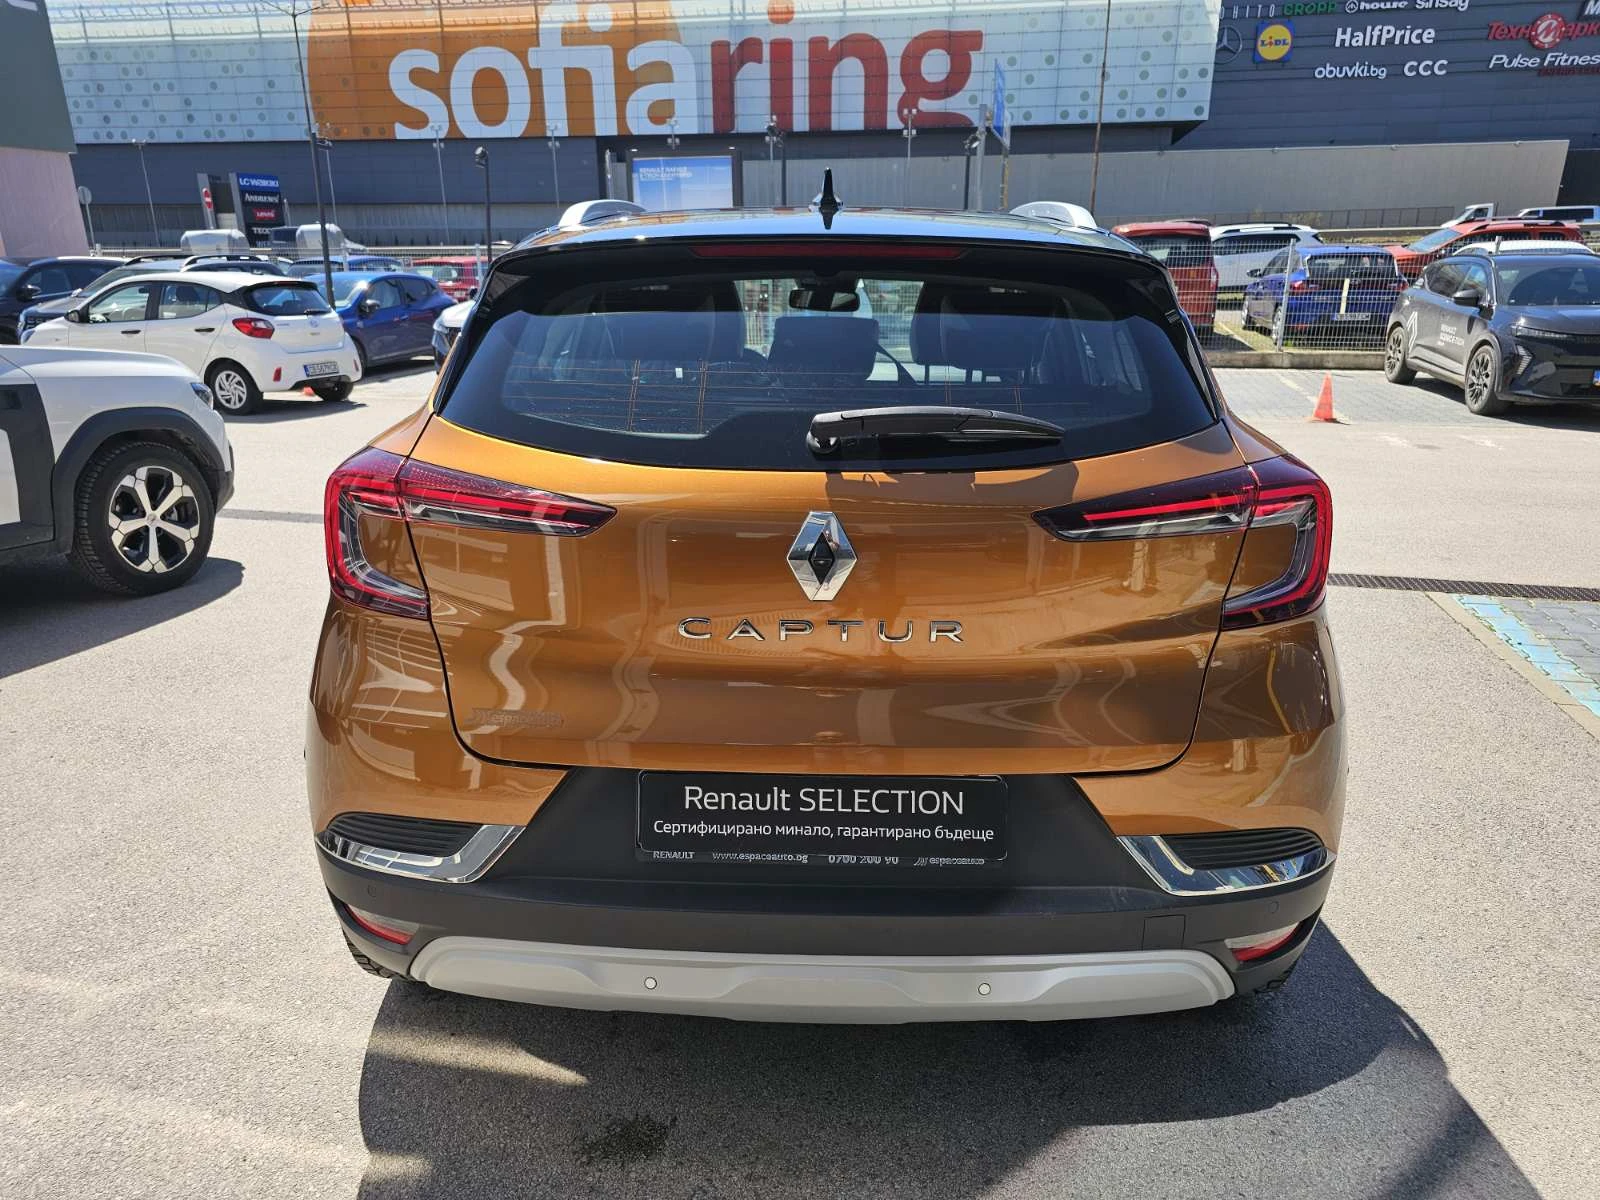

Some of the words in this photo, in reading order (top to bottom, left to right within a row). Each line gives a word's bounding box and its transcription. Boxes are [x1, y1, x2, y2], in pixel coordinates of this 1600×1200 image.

[1335, 25, 1436, 47] HalfPrice
[1315, 61, 1387, 80] obuvki.bg
[1403, 59, 1449, 77] CCC
[1489, 54, 1540, 69] Pulse
[677, 617, 965, 643] CAPTUR
[684, 786, 792, 812] Renault
[799, 788, 965, 816] SELECTION
[653, 820, 772, 838] Сертифицирано
[775, 825, 834, 838] минало,
[837, 826, 931, 841] гарантирано
[934, 825, 995, 843] бъдеще
[652, 850, 695, 860] RENAULT
